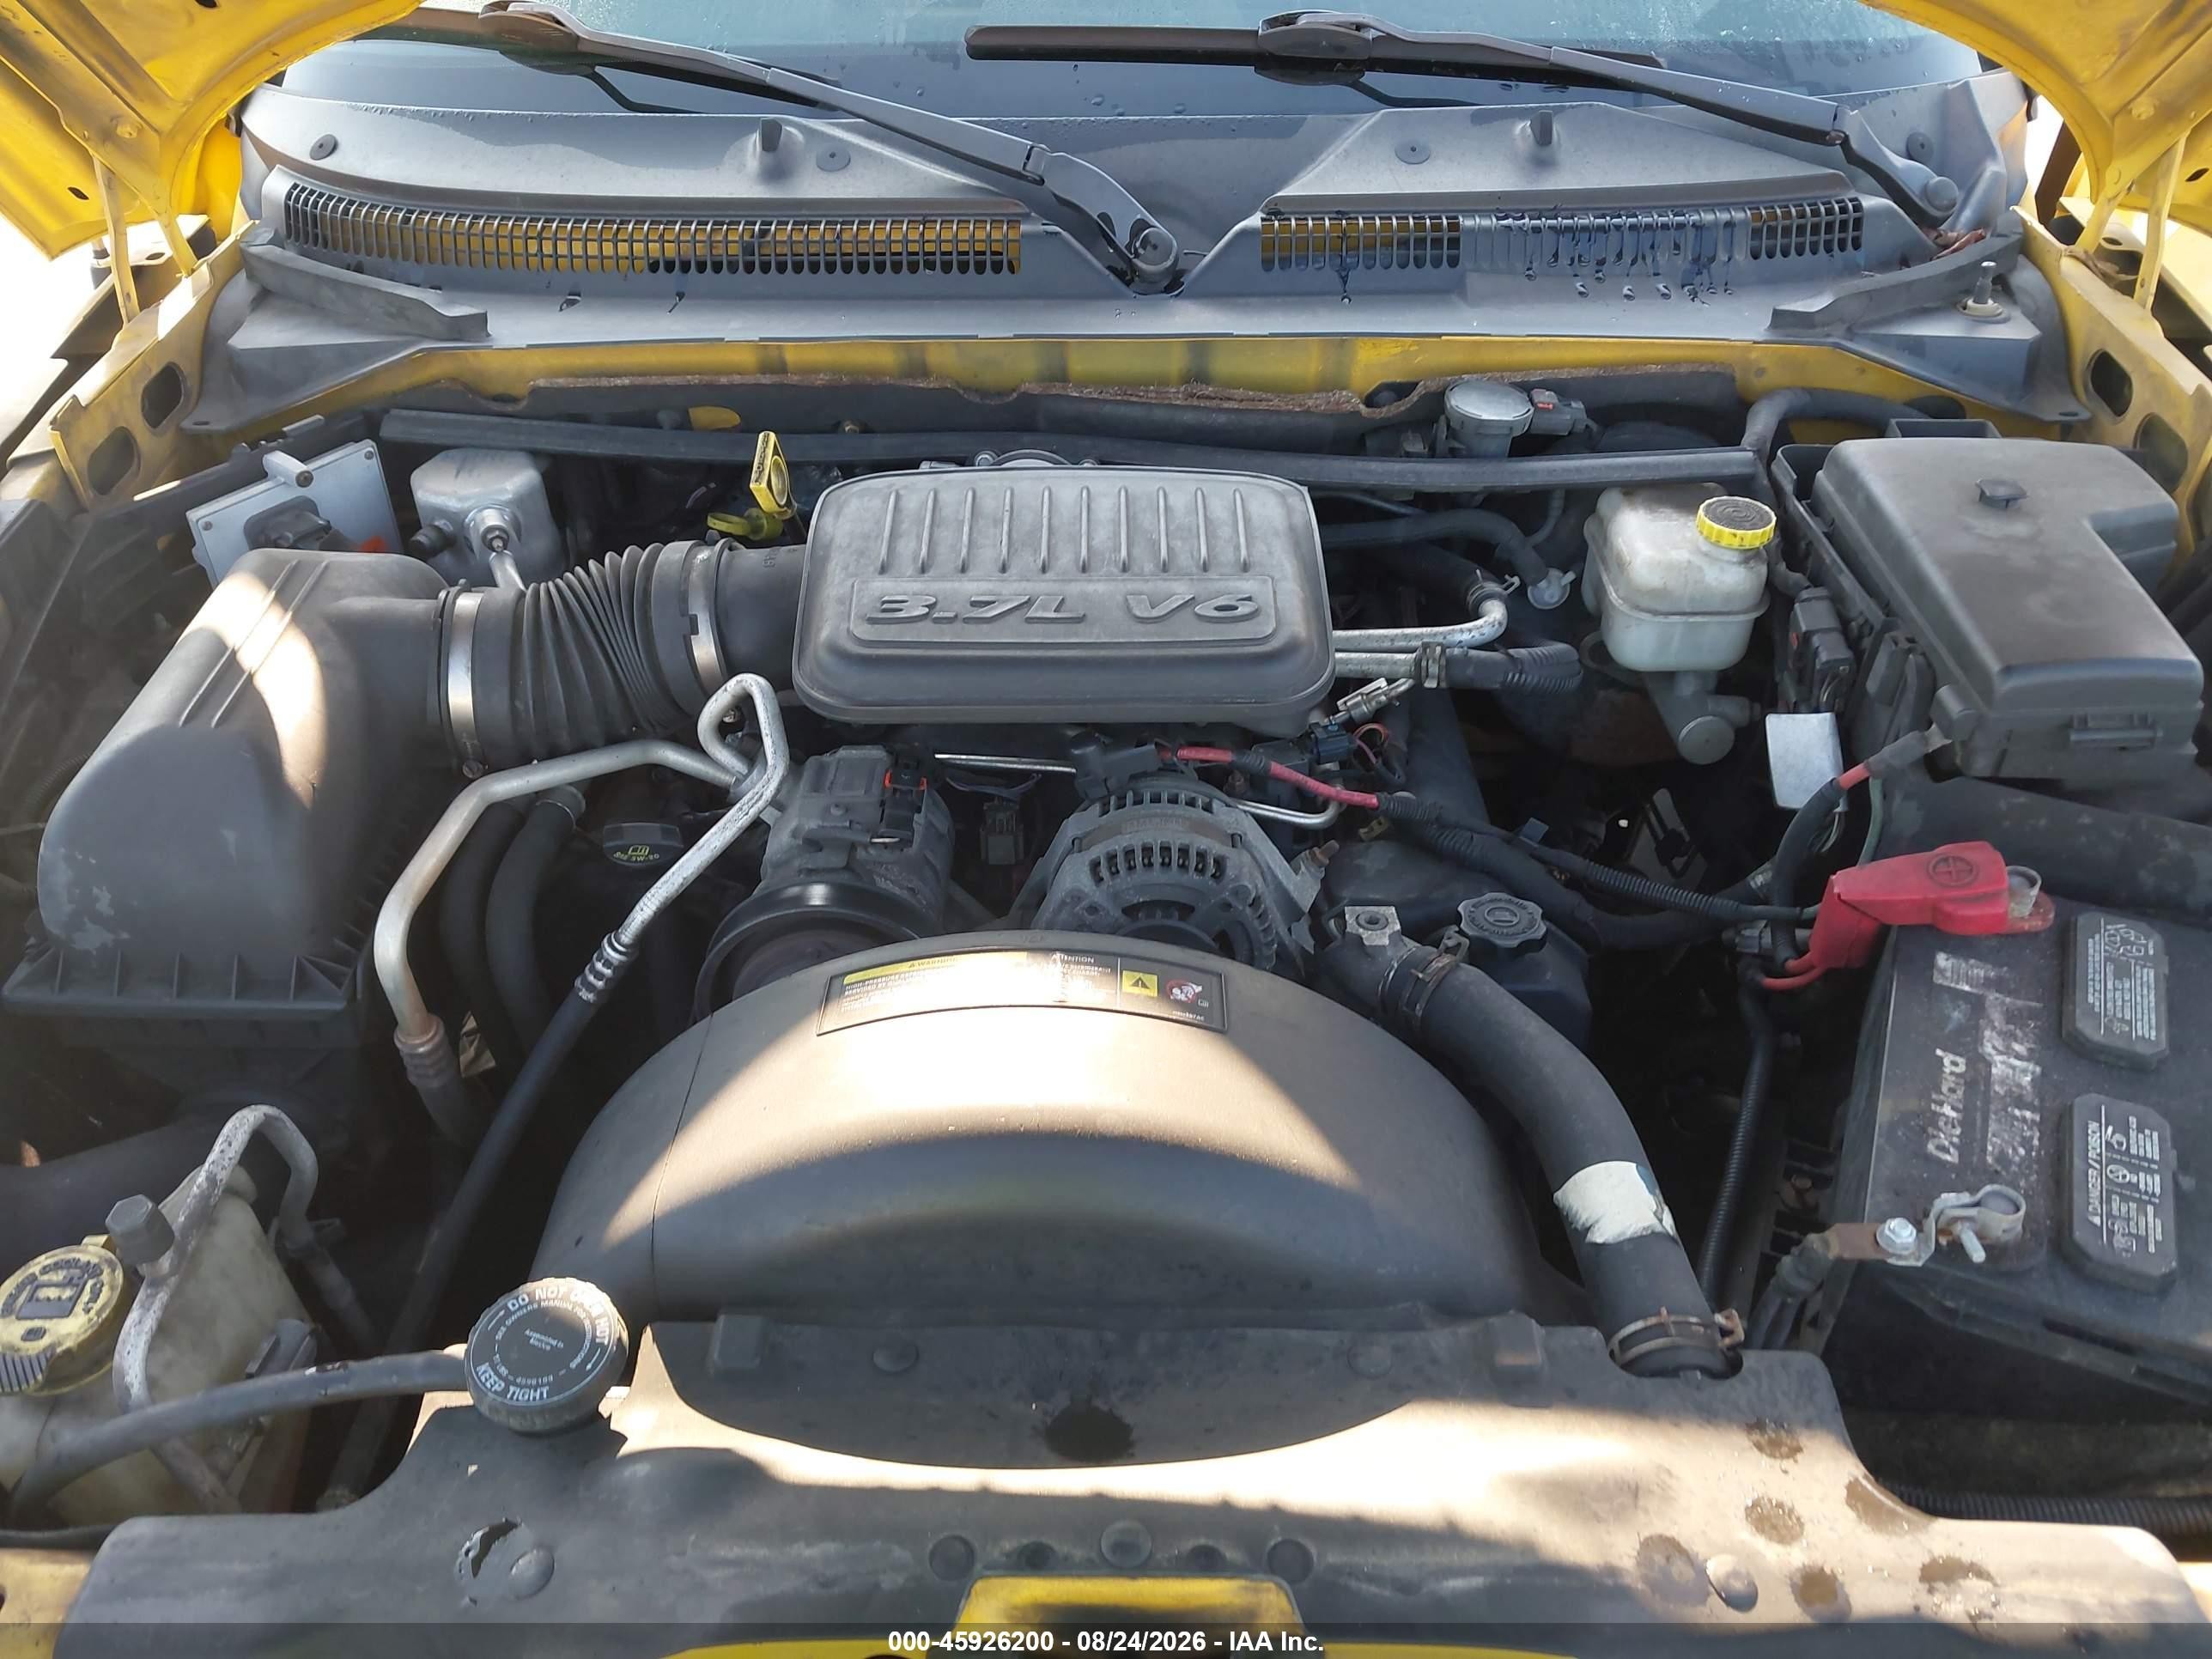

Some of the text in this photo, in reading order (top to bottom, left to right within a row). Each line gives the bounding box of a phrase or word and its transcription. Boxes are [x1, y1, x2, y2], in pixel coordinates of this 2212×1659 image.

[866, 593, 1260, 623] 3.7L V6
[1927, 1048, 1966, 1164] DieHard
[507, 1292, 530, 1312] DO
[476, 1361, 506, 1392] KEEP
[507, 1384, 550, 1402] TIGHT
